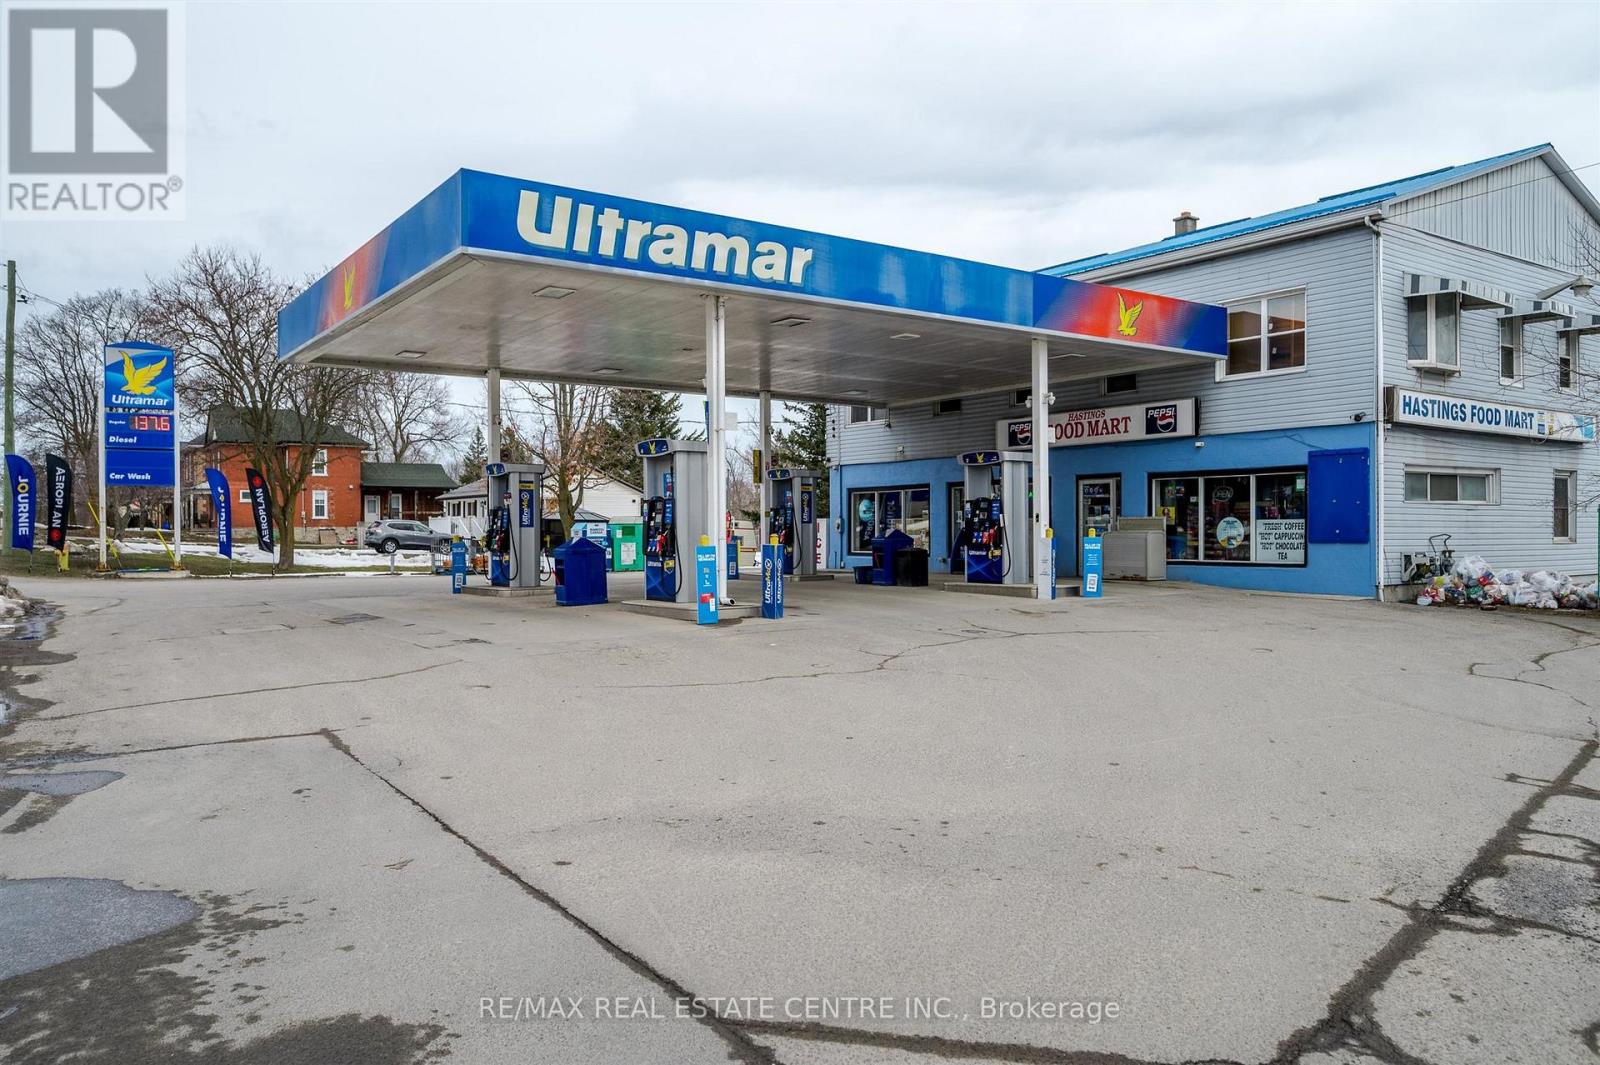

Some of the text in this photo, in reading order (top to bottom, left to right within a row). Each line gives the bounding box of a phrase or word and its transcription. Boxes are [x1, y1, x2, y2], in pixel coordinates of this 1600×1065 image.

[516, 189, 813, 284] Ultramar
[112, 394, 170, 406] Ultramar
[1068, 409, 1106, 422] HASTINGS
[1147, 407, 1176, 418] PEPSI
[1402, 394, 1467, 423] HASTINGS
[1471, 404, 1501, 426] FOOD
[1505, 409, 1535, 430] MART
[1009, 422, 1032, 432] PEPSI
[1048, 416, 1132, 441] OOD MART
[109, 435, 137, 443] Diesel
[109, 472, 125, 480] Car
[51, 466, 66, 528] AEROPLAN
[17, 475, 29, 536] JOURNIE
[255, 488, 270, 543] AEROPLAN
[1284, 522, 1304, 530] COFFEE
[1275, 542, 1305, 550] CHOCOLATE
[1278, 552, 1288, 560] TEA
